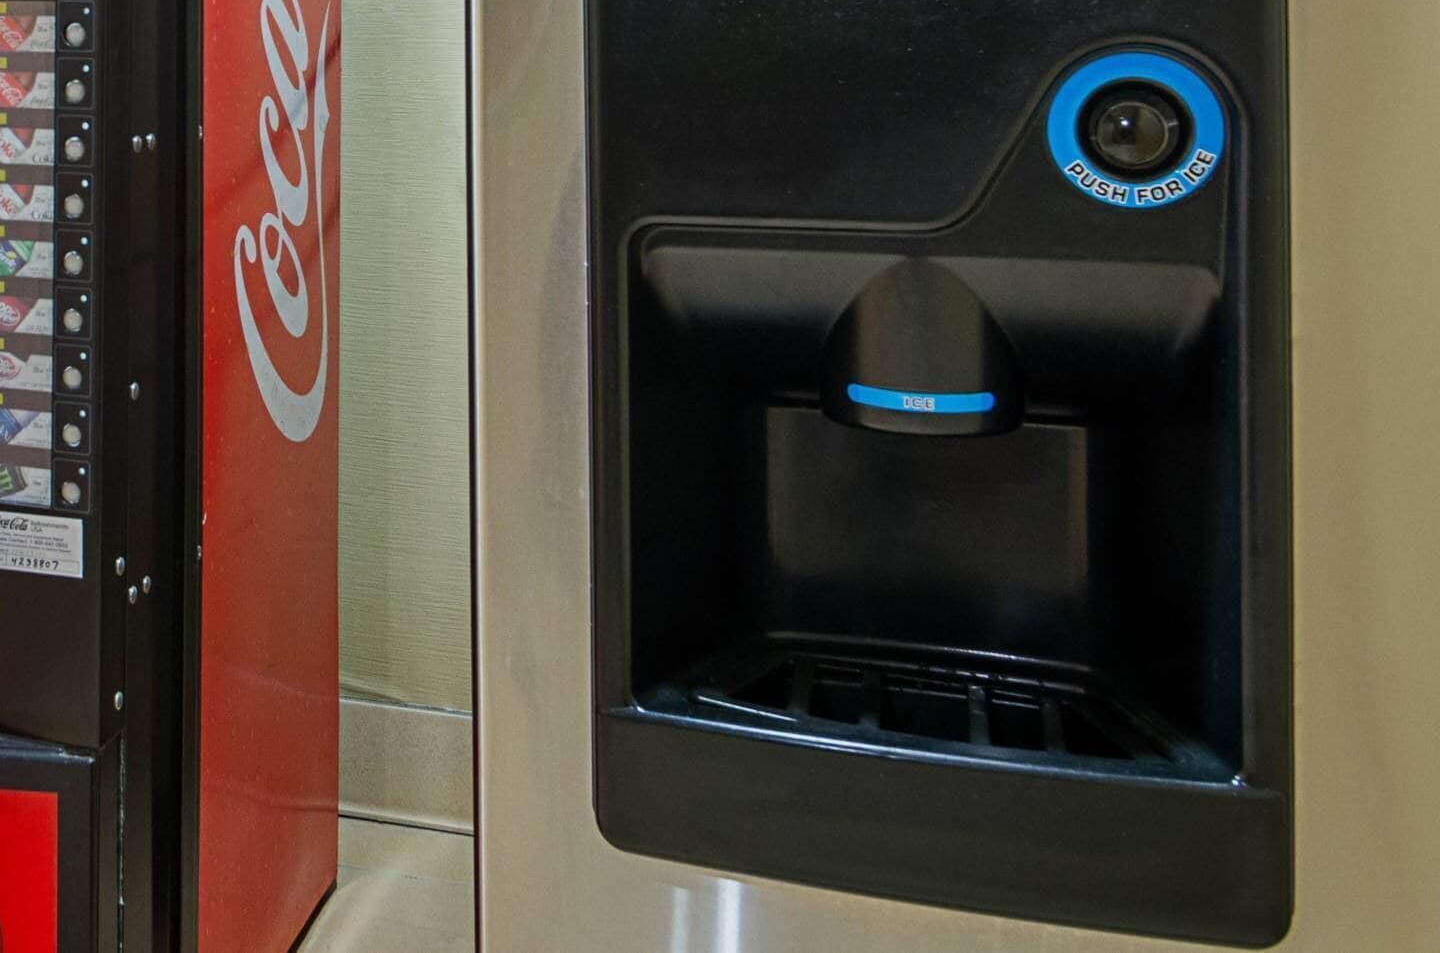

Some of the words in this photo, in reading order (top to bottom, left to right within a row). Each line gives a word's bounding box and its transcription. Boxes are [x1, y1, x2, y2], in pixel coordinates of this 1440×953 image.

[1065, 160, 1128, 204] PUSH
[1135, 178, 1184, 205] FOR
[1182, 148, 1217, 185] ICE
[903, 396, 935, 412] ICE
